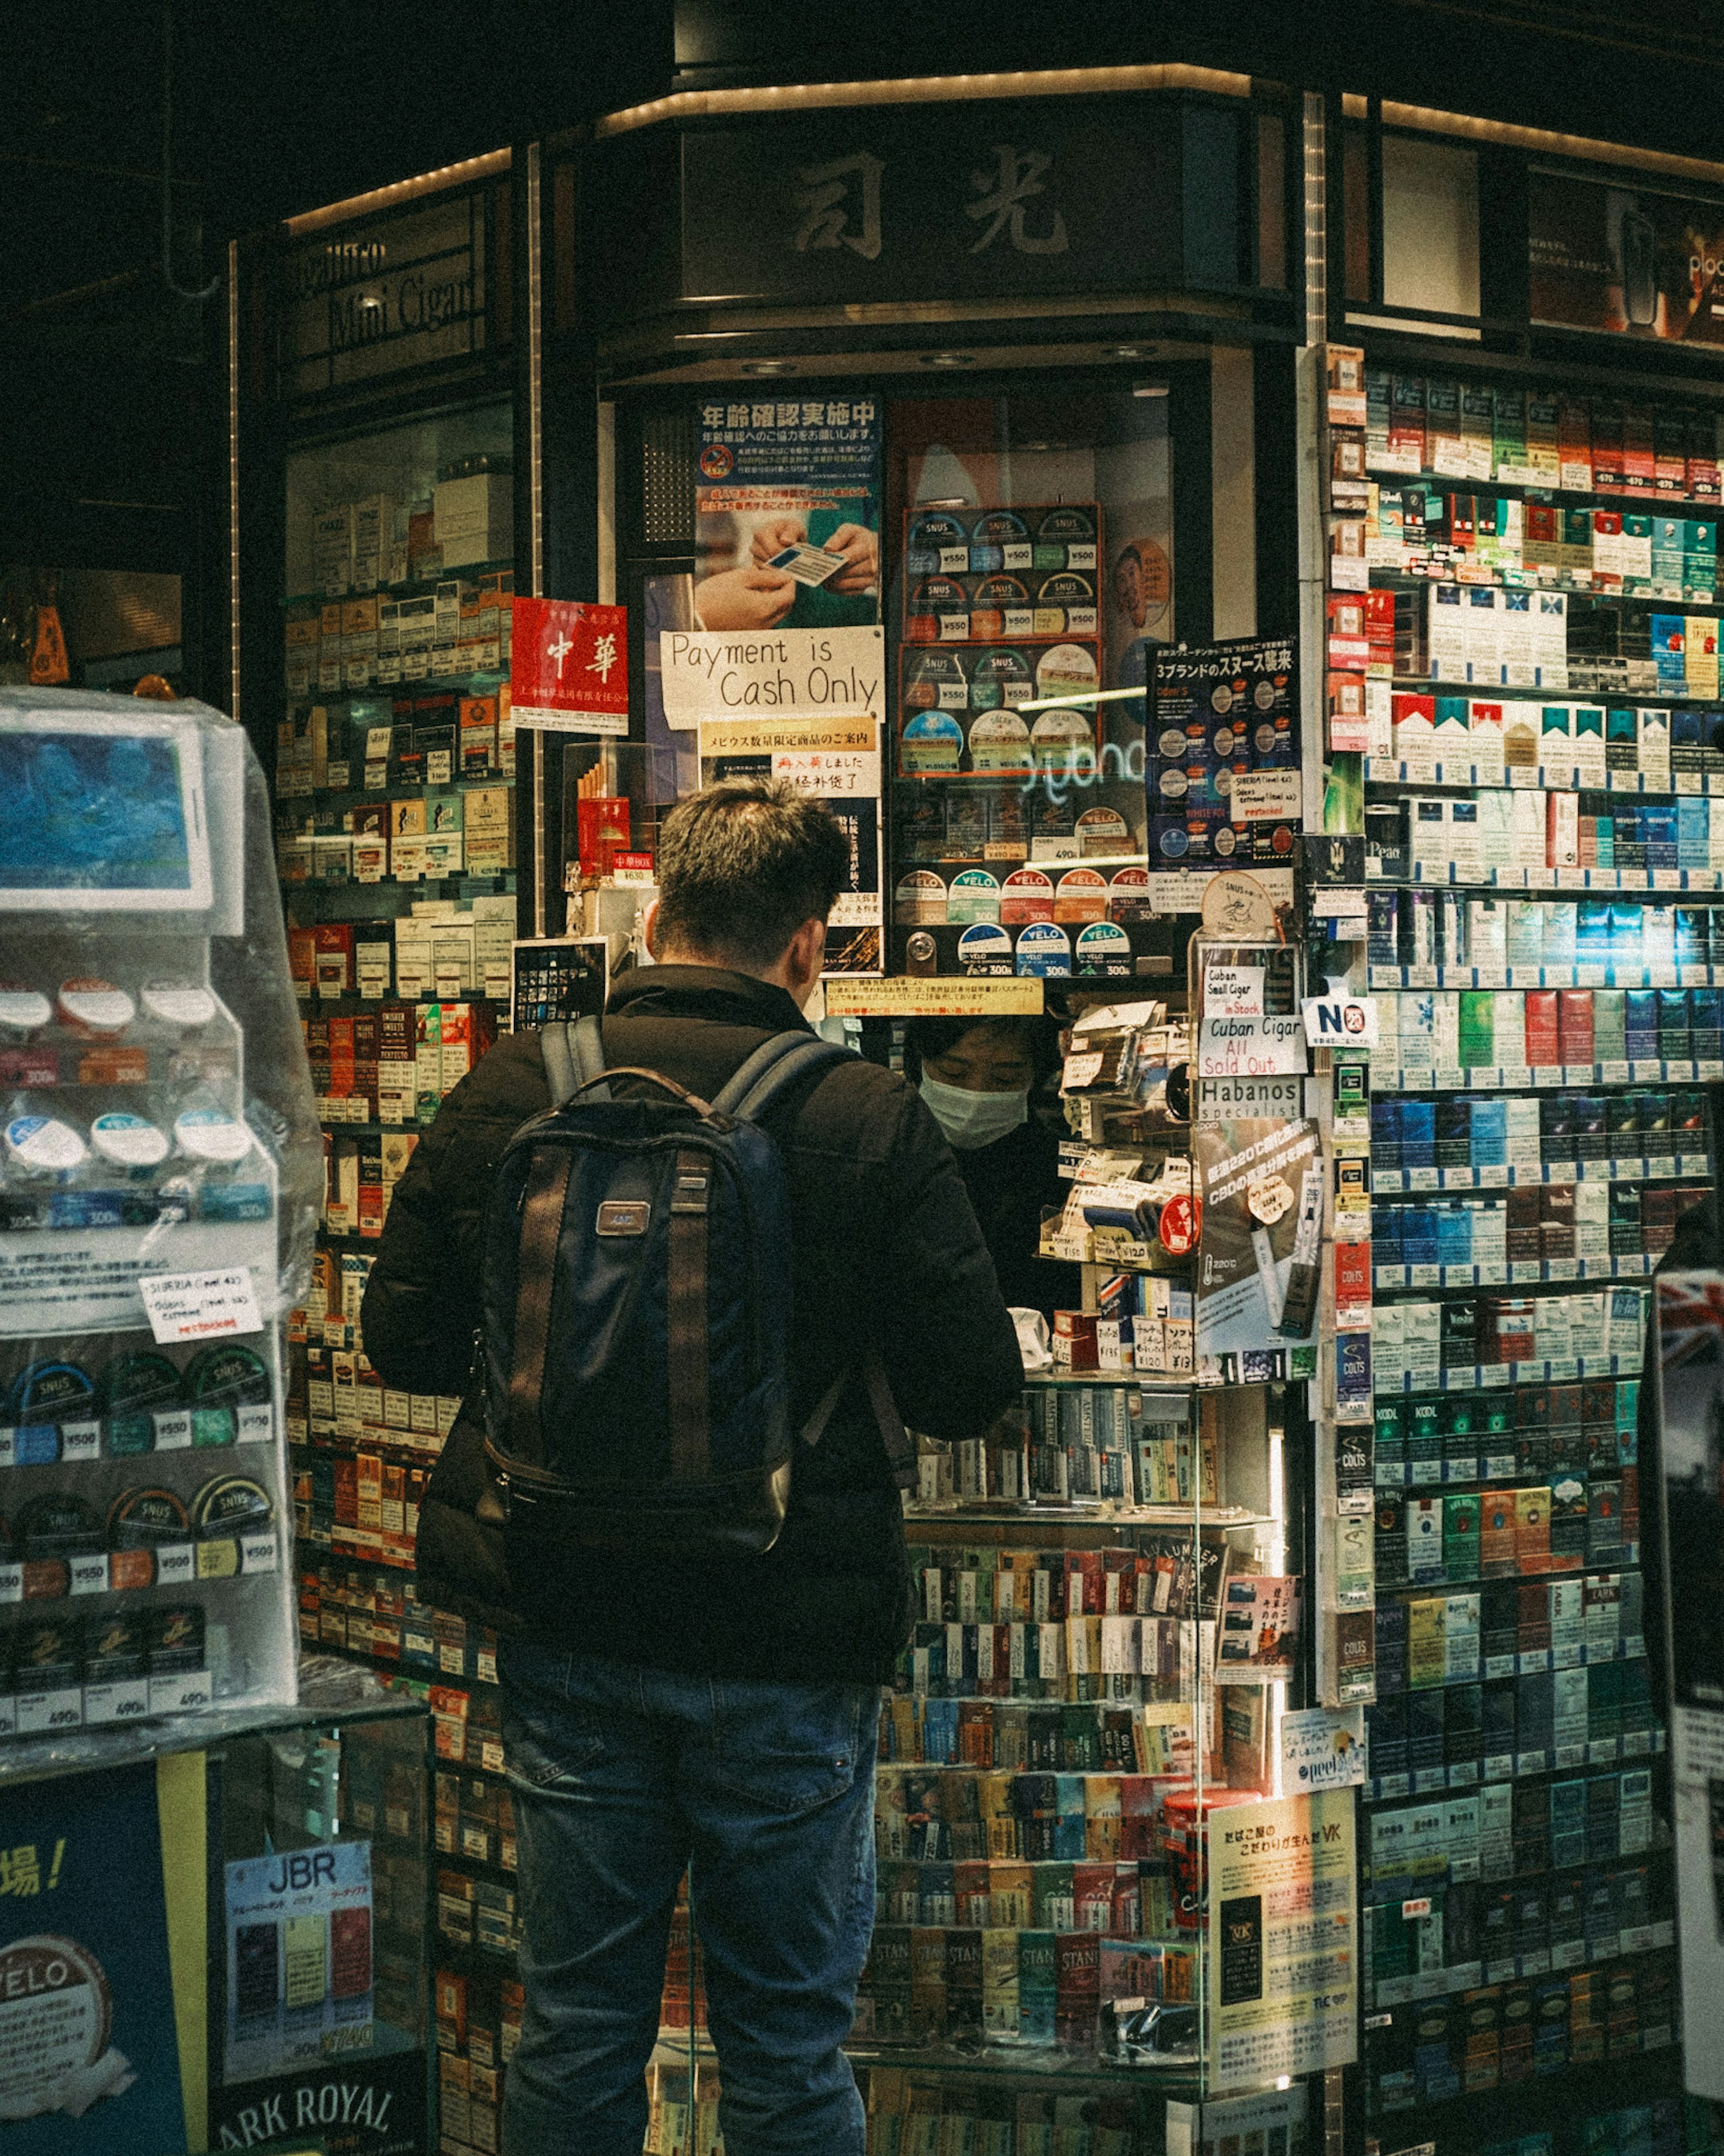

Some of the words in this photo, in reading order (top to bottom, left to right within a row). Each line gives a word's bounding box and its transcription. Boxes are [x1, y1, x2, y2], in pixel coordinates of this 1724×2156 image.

[329, 285, 388, 350] Mini
[702, 402, 875, 428] 年齢確認実施中
[926, 523, 948, 532] SNUS
[989, 521, 1011, 531] SNUS
[1055, 519, 1078, 527] SNUS
[928, 585, 950, 595] SNUS
[991, 584, 1012, 593] SNUS
[1055, 582, 1077, 591] SNUS
[672, 634, 787, 678] Payment
[811, 636, 832, 662] is
[721, 670, 795, 706] Cash
[809, 666, 878, 711] Only
[709, 732, 868, 748] メビウス数量限定商品のご案内
[1028, 929, 1059, 939] VELO
[1087, 928, 1119, 939] VELO
[1209, 970, 1236, 981] Cuban
[1208, 983, 1228, 994] Small
[1230, 984, 1251, 998] Cigar
[1234, 1001, 1260, 1015] Stock
[1211, 1018, 1254, 1037] Cuban
[1262, 1018, 1302, 1042] Cigar
[1226, 1041, 1247, 1055] All
[1205, 1057, 1239, 1074] Sold
[1248, 1057, 1277, 1074] Out
[1202, 1082, 1297, 1102] Habanos
[1202, 1103, 1297, 1119] specialist
[1139, 1356, 1161, 1367] ¥120
[1173, 1355, 1190, 1367] ¥13
[1344, 1361, 1365, 1374] COLTS
[1376, 1407, 1398, 1420] KOOL
[1415, 1406, 1437, 1418] KOOL
[1342, 1454, 1366, 1468] COLTS
[1165, 1543, 1219, 1566] LUMER
[1344, 1640, 1367, 1655] COLTS
[1322, 1824, 1341, 1842] VK
[269, 1852, 336, 1894] JBR
[295, 2085, 392, 2133] ROYAL
